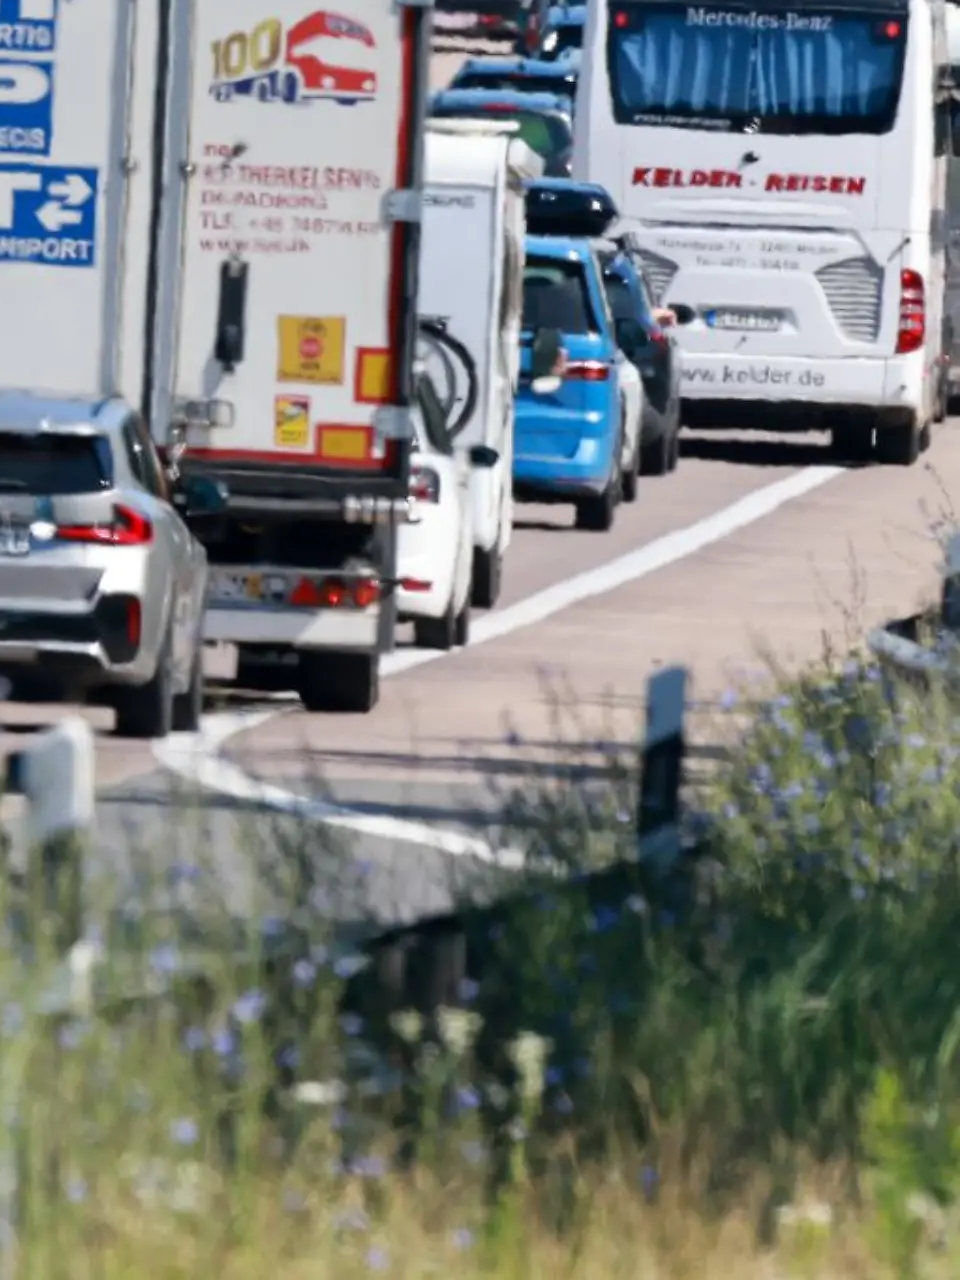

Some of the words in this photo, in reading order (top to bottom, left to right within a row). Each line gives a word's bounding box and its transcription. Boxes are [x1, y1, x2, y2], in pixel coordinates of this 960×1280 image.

[685, 7, 833, 32] Mercedes-Benz
[211, 16, 283, 81] 100
[632, 166, 744, 189] KELDER
[764, 172, 867, 196] REISEN
